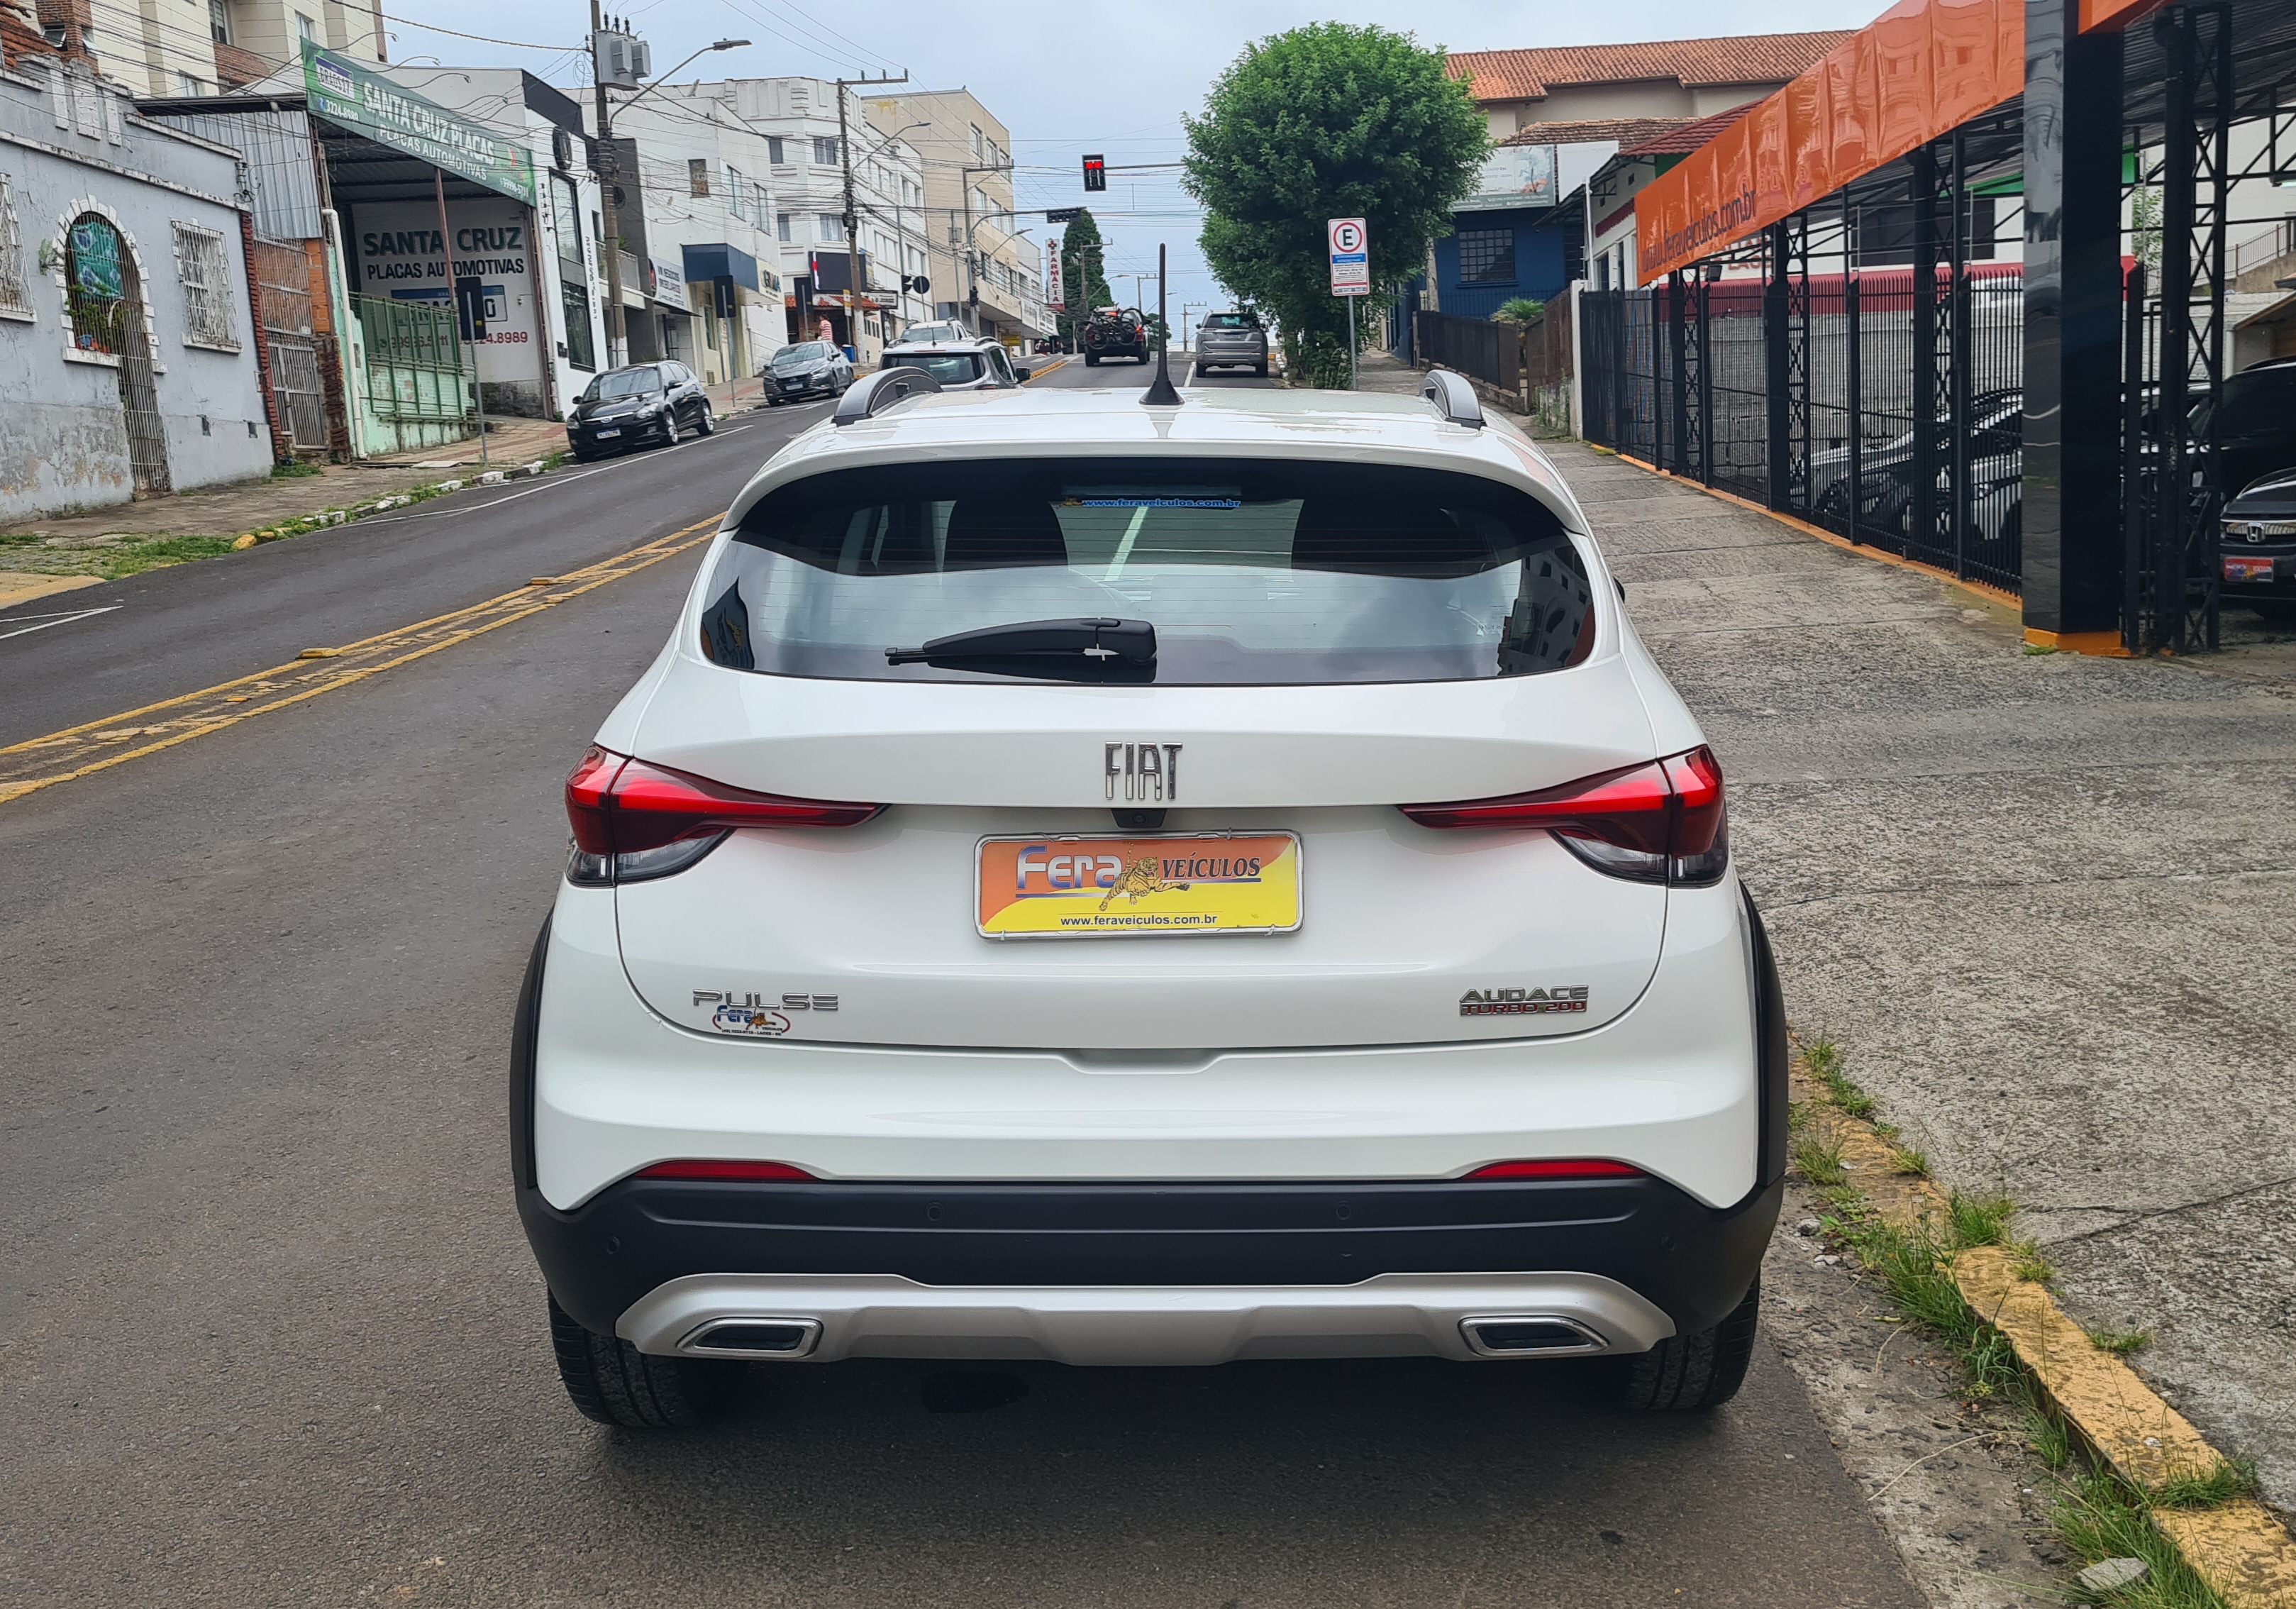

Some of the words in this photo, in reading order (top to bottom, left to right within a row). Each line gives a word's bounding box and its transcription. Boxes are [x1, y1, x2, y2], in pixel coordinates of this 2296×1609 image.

[364, 82, 411, 129] SANTA
[414, 106, 449, 145] CRUZ
[451, 123, 495, 166] PLACAS
[379, 123, 421, 153] PLACAS
[423, 142, 487, 181] AUTOMOTIVAS
[364, 230, 445, 257] SANTA
[456, 226, 524, 253] CRUZ
[1343, 228, 1353, 246] E
[367, 262, 423, 280] PLACAS
[1050, 250, 1060, 302] FARMACIA
[1082, 498, 1241, 507] www.feraveiculos.com.br
[1104, 741, 1183, 800] FIAT
[1162, 853, 1262, 879] VEÍCULOS
[1060, 914, 1218, 927] www.feraveiculos.com.br
[693, 989, 838, 1011] PULSE
[1459, 984, 1589, 1003] AUDACE
[1462, 1004, 1539, 1015] TURBO
[1544, 1001, 1586, 1012] 200
